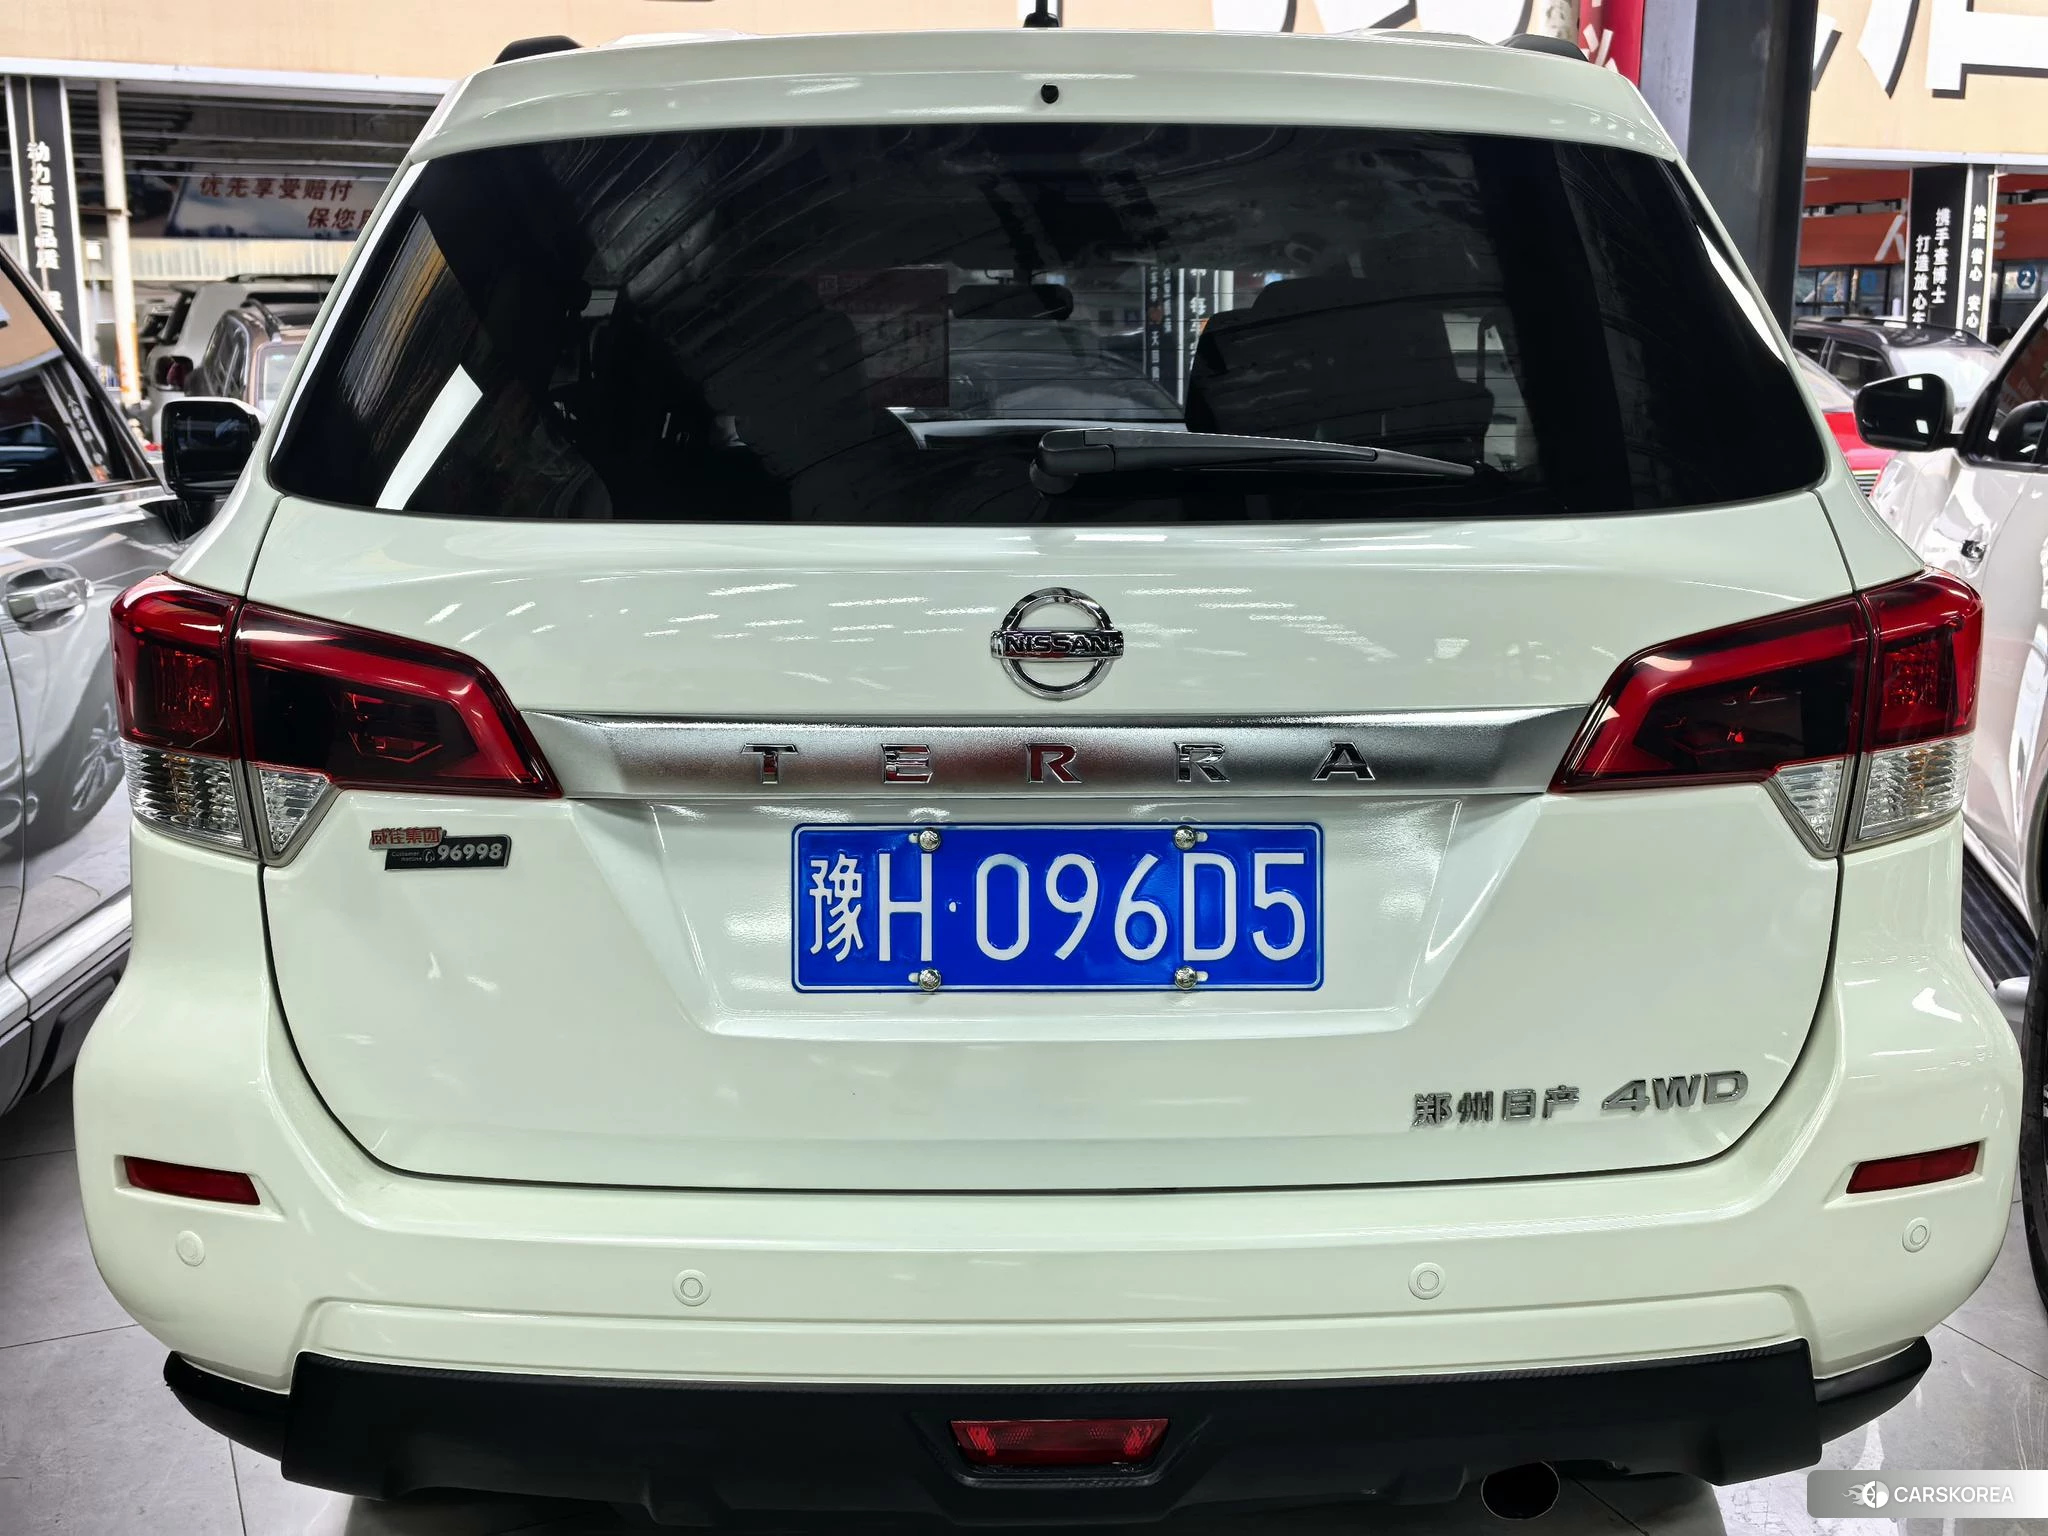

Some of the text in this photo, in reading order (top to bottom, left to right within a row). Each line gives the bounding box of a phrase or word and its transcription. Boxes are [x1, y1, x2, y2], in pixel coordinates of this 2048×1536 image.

[200, 174, 353, 202] 优先享受赔付
[1930, 207, 1951, 304] 携手查博士
[1004, 634, 1111, 655] NISSAN
[740, 741, 1377, 784] TERRA
[371, 827, 442, 846] 威佳集团
[437, 842, 504, 862] 96998
[1411, 1069, 1750, 1127] 郑州日产 4WD
